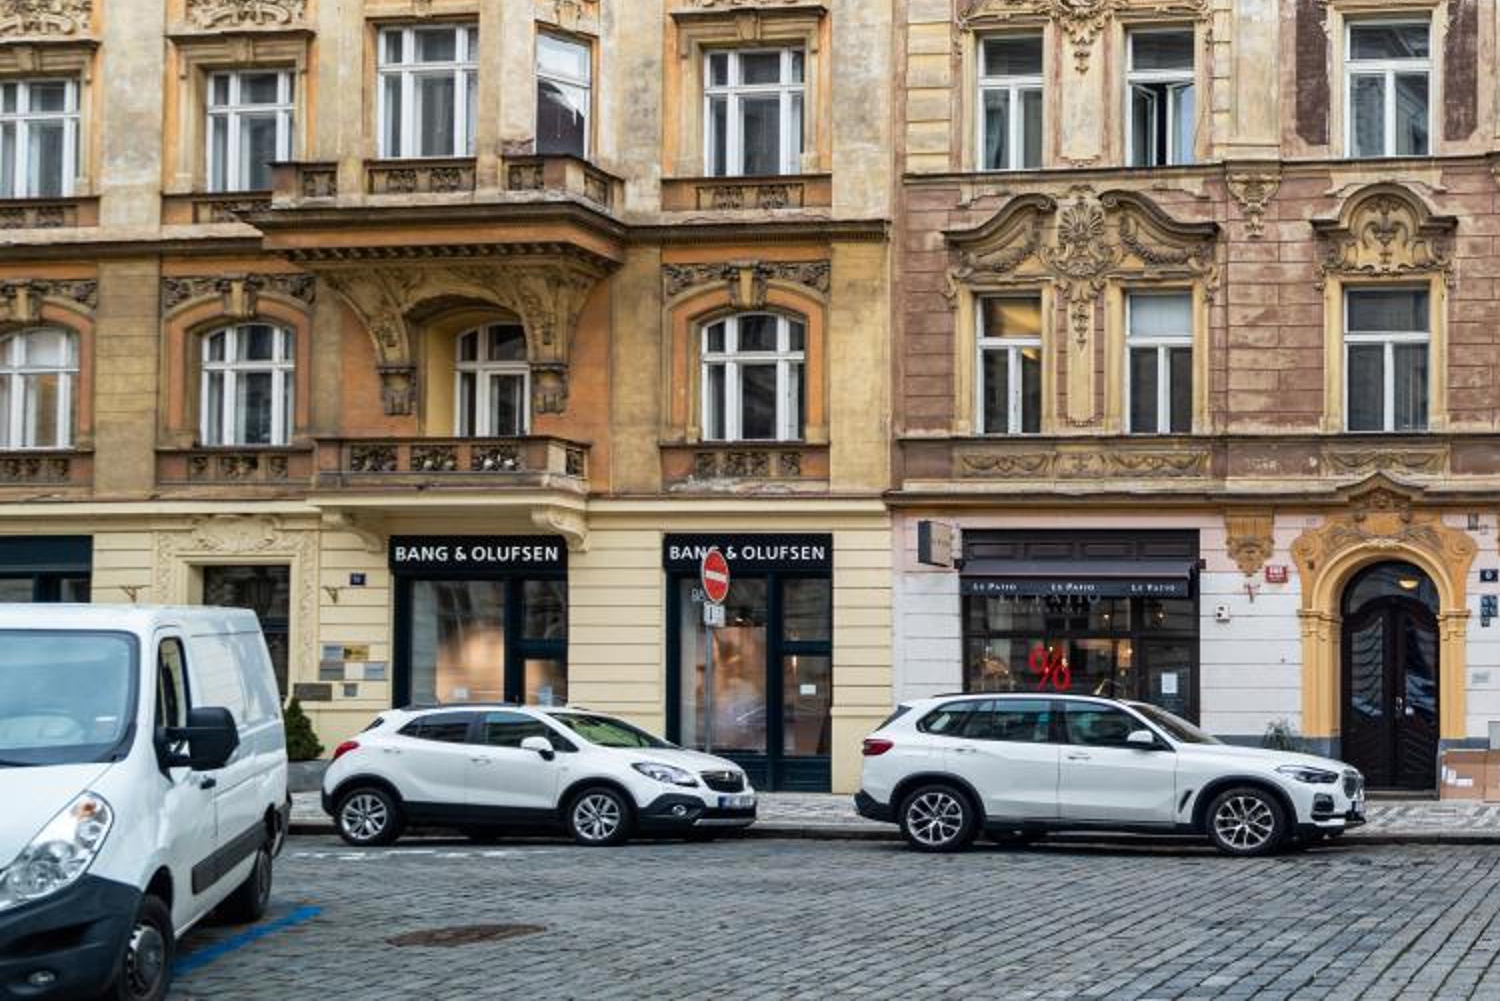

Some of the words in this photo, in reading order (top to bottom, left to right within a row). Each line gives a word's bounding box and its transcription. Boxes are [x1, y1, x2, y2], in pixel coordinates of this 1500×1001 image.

[394, 546, 449, 562] BANG
[454, 546, 467, 562] &
[471, 546, 559, 562] OLUFSEN
[725, 546, 738, 560] &
[741, 546, 825, 560] OLUFSEN
